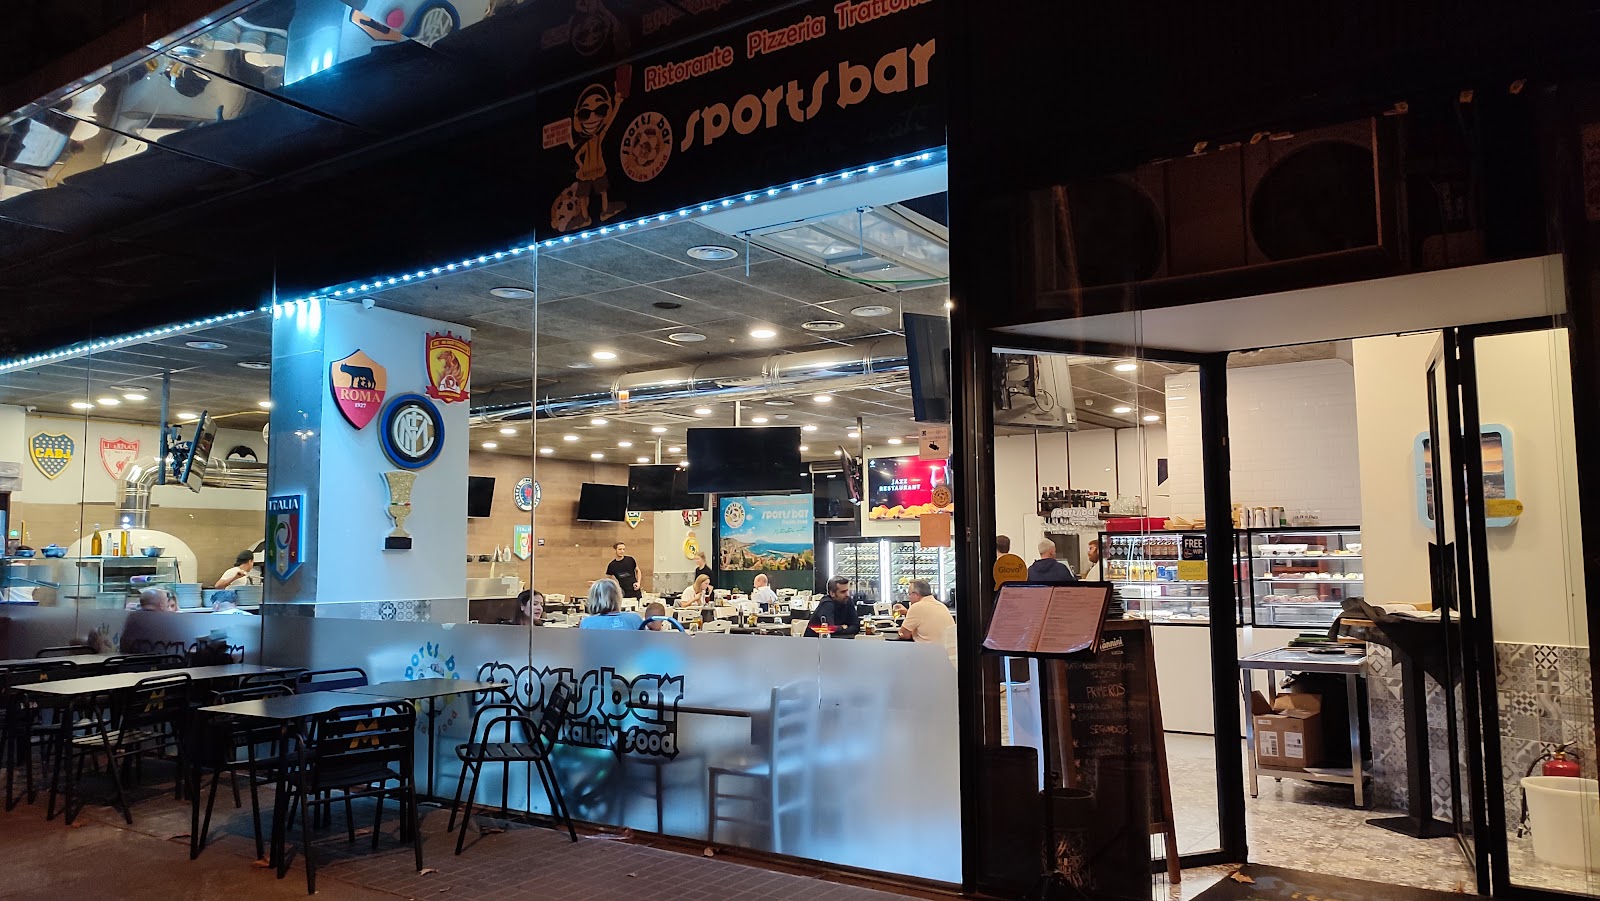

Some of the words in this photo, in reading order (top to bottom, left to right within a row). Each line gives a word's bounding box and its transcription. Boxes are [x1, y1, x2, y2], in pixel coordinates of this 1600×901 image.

[644, 46, 734, 92] Ristorante
[746, 15, 826, 59] Pizzeria
[680, 70, 829, 152] sports
[836, 38, 936, 109] bar
[656, 118, 670, 145] bar
[340, 388, 382, 403] ROMA
[878, 484, 921, 492] RESTAURANT
[890, 478, 908, 486] JAZZ
[268, 498, 299, 511] ITALIA
[1184, 538, 1203, 549] FREE
[597, 667, 685, 724] bar
[625, 728, 677, 752] food
